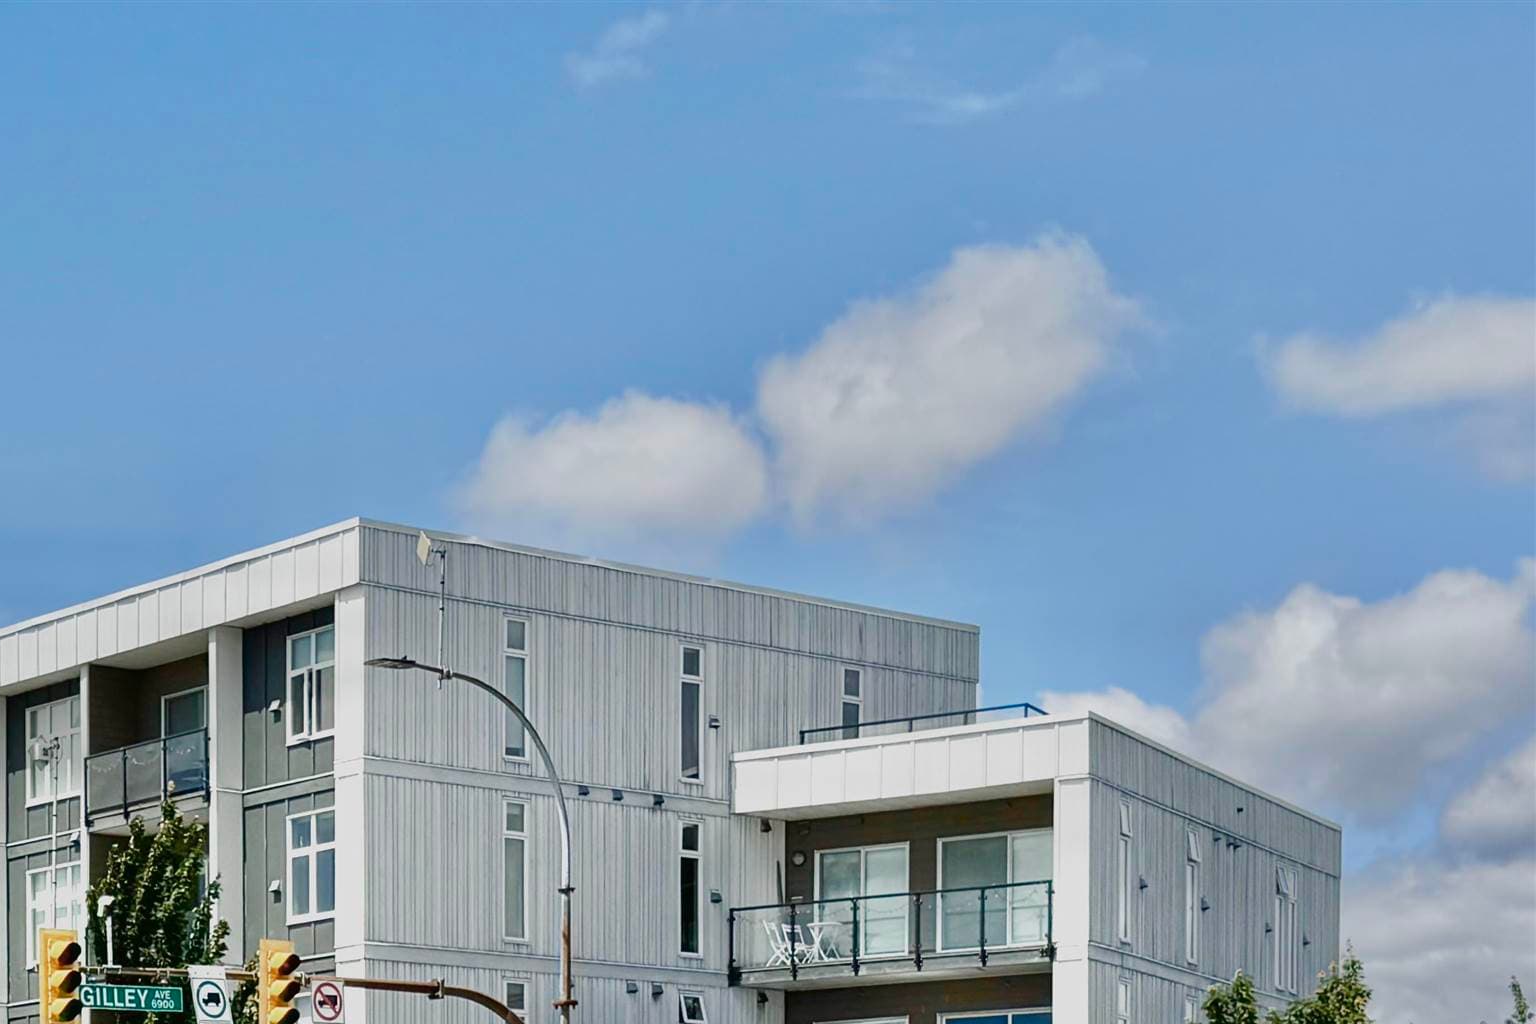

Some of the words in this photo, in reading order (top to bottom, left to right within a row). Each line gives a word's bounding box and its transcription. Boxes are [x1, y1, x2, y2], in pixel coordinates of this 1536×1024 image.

[80, 987, 148, 1007] GILLEY
[154, 990, 171, 1000] AVE
[151, 999, 175, 1009] 6900
